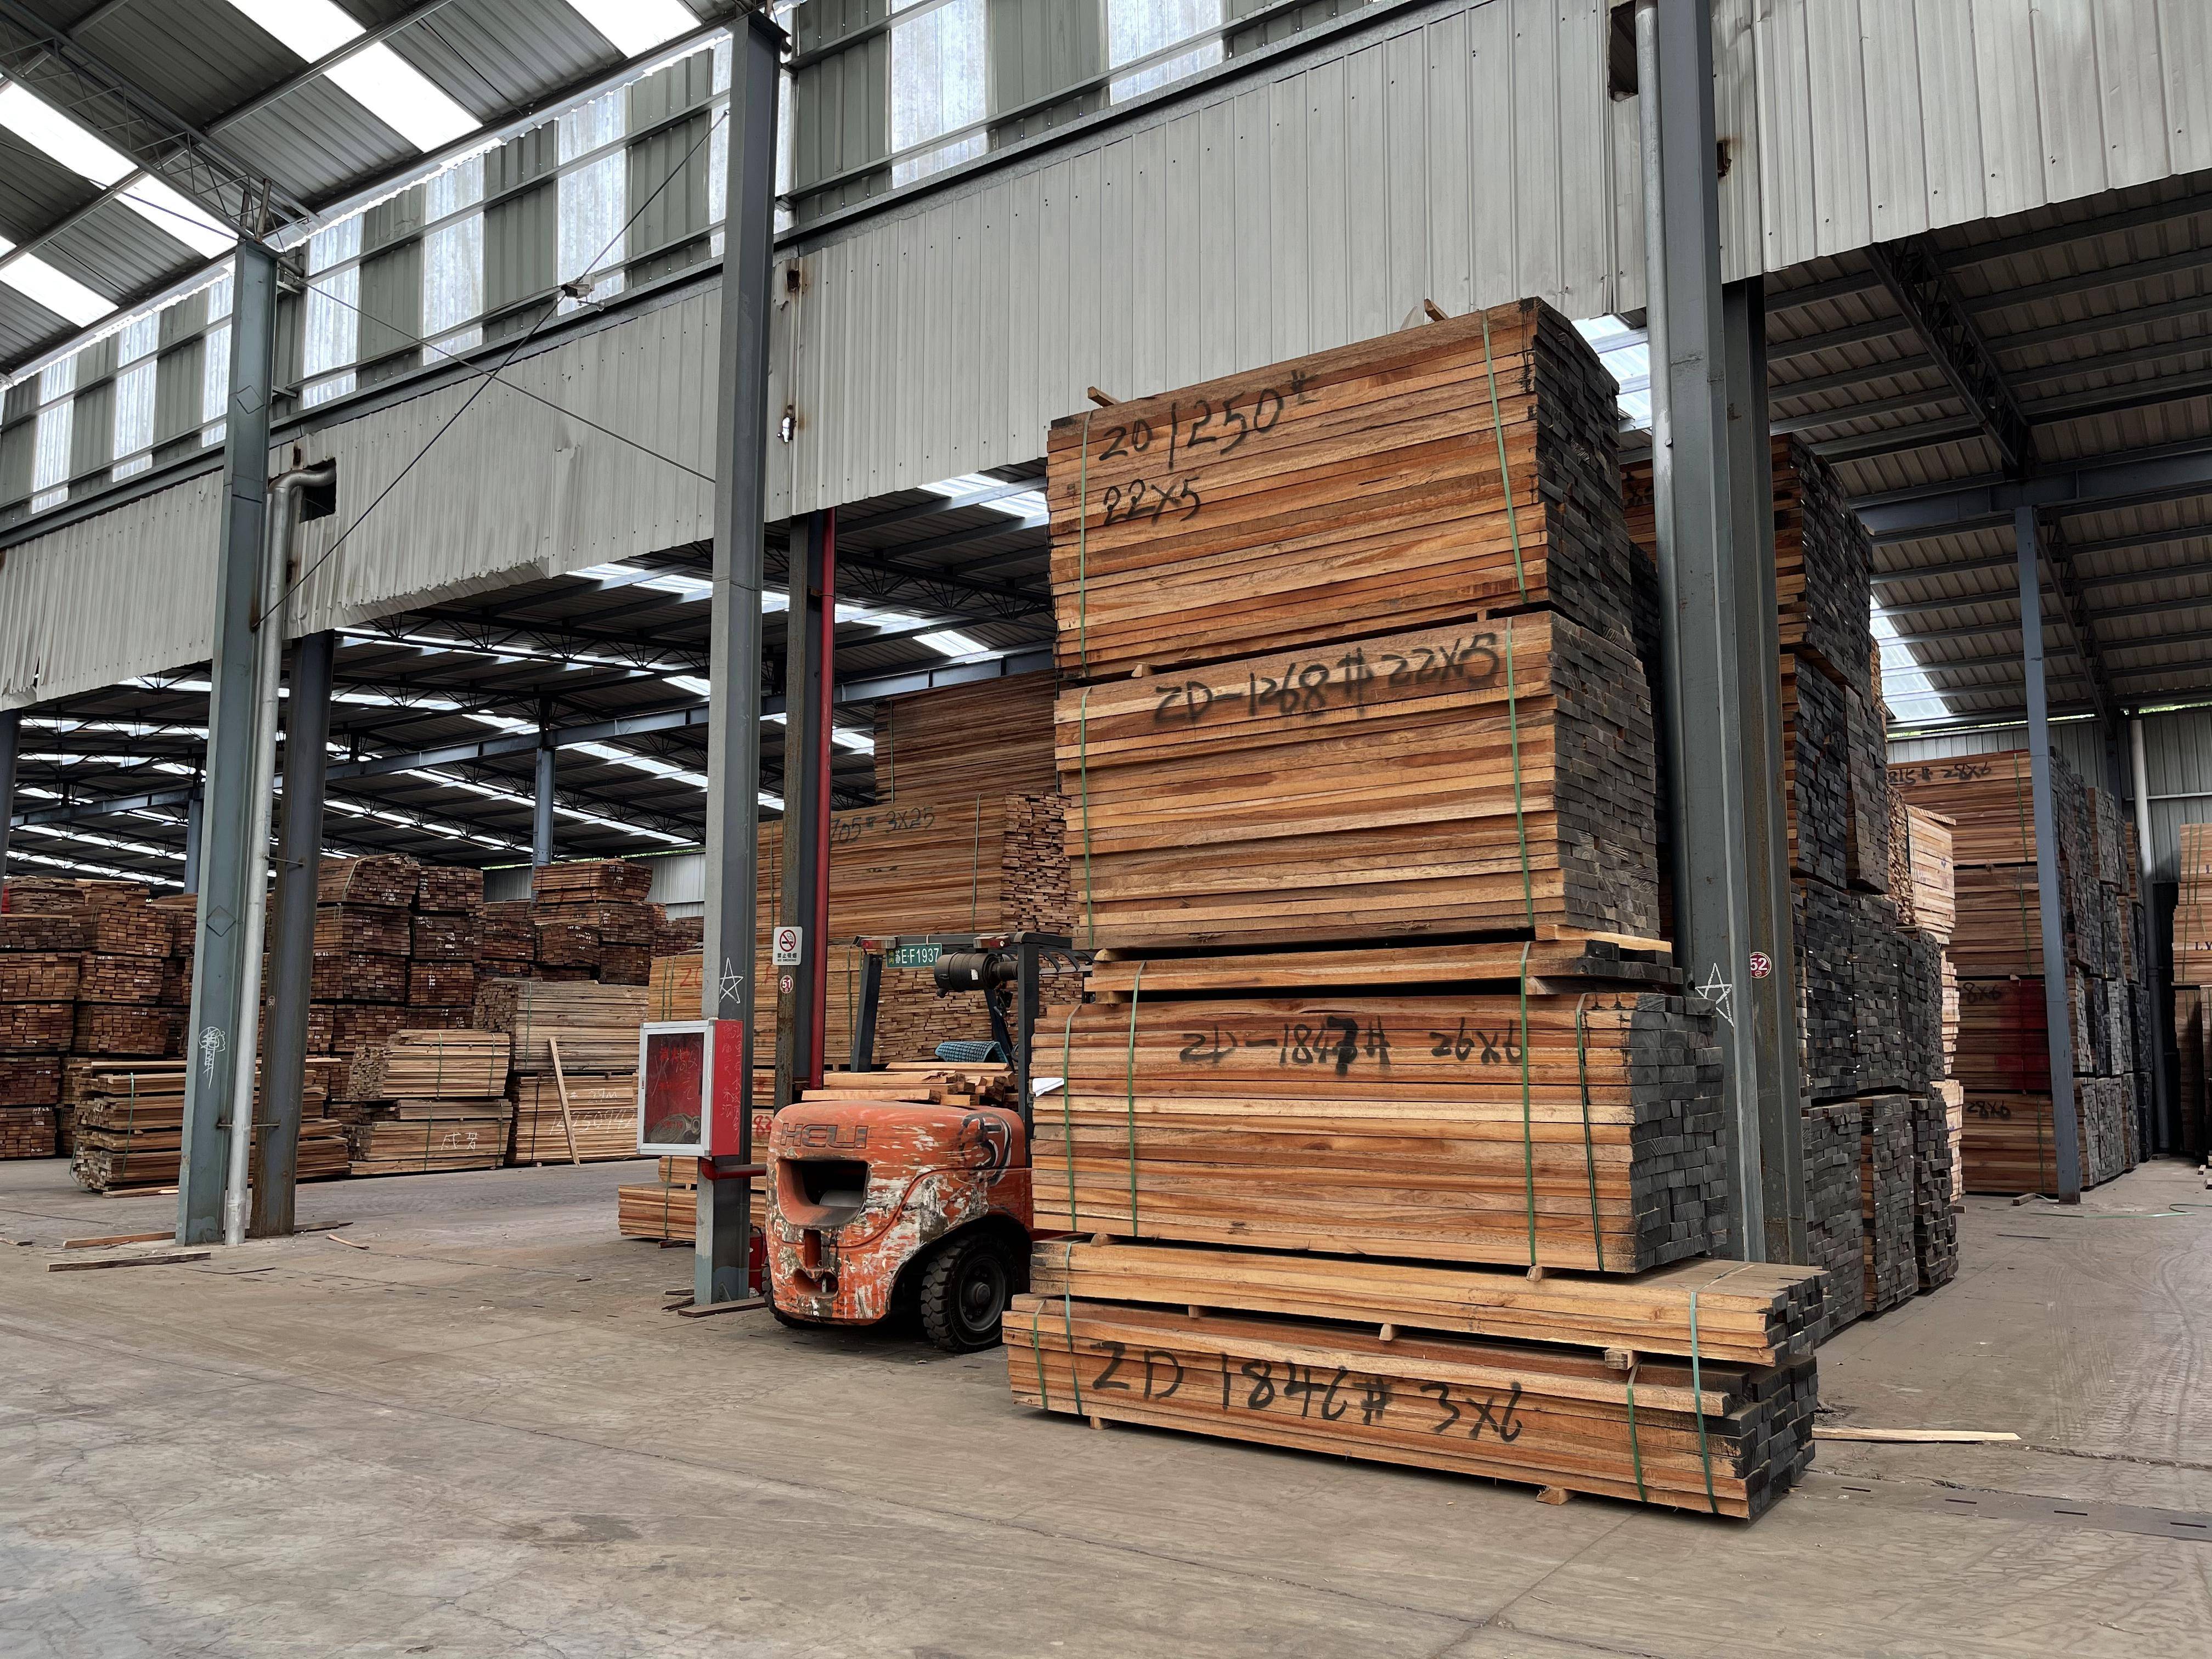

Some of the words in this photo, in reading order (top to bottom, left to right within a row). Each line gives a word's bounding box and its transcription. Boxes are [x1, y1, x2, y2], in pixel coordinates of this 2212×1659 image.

[1750, 957, 1768, 971] 52
[782, 979, 791, 989] 51
[780, 1122, 869, 1149] HELI
